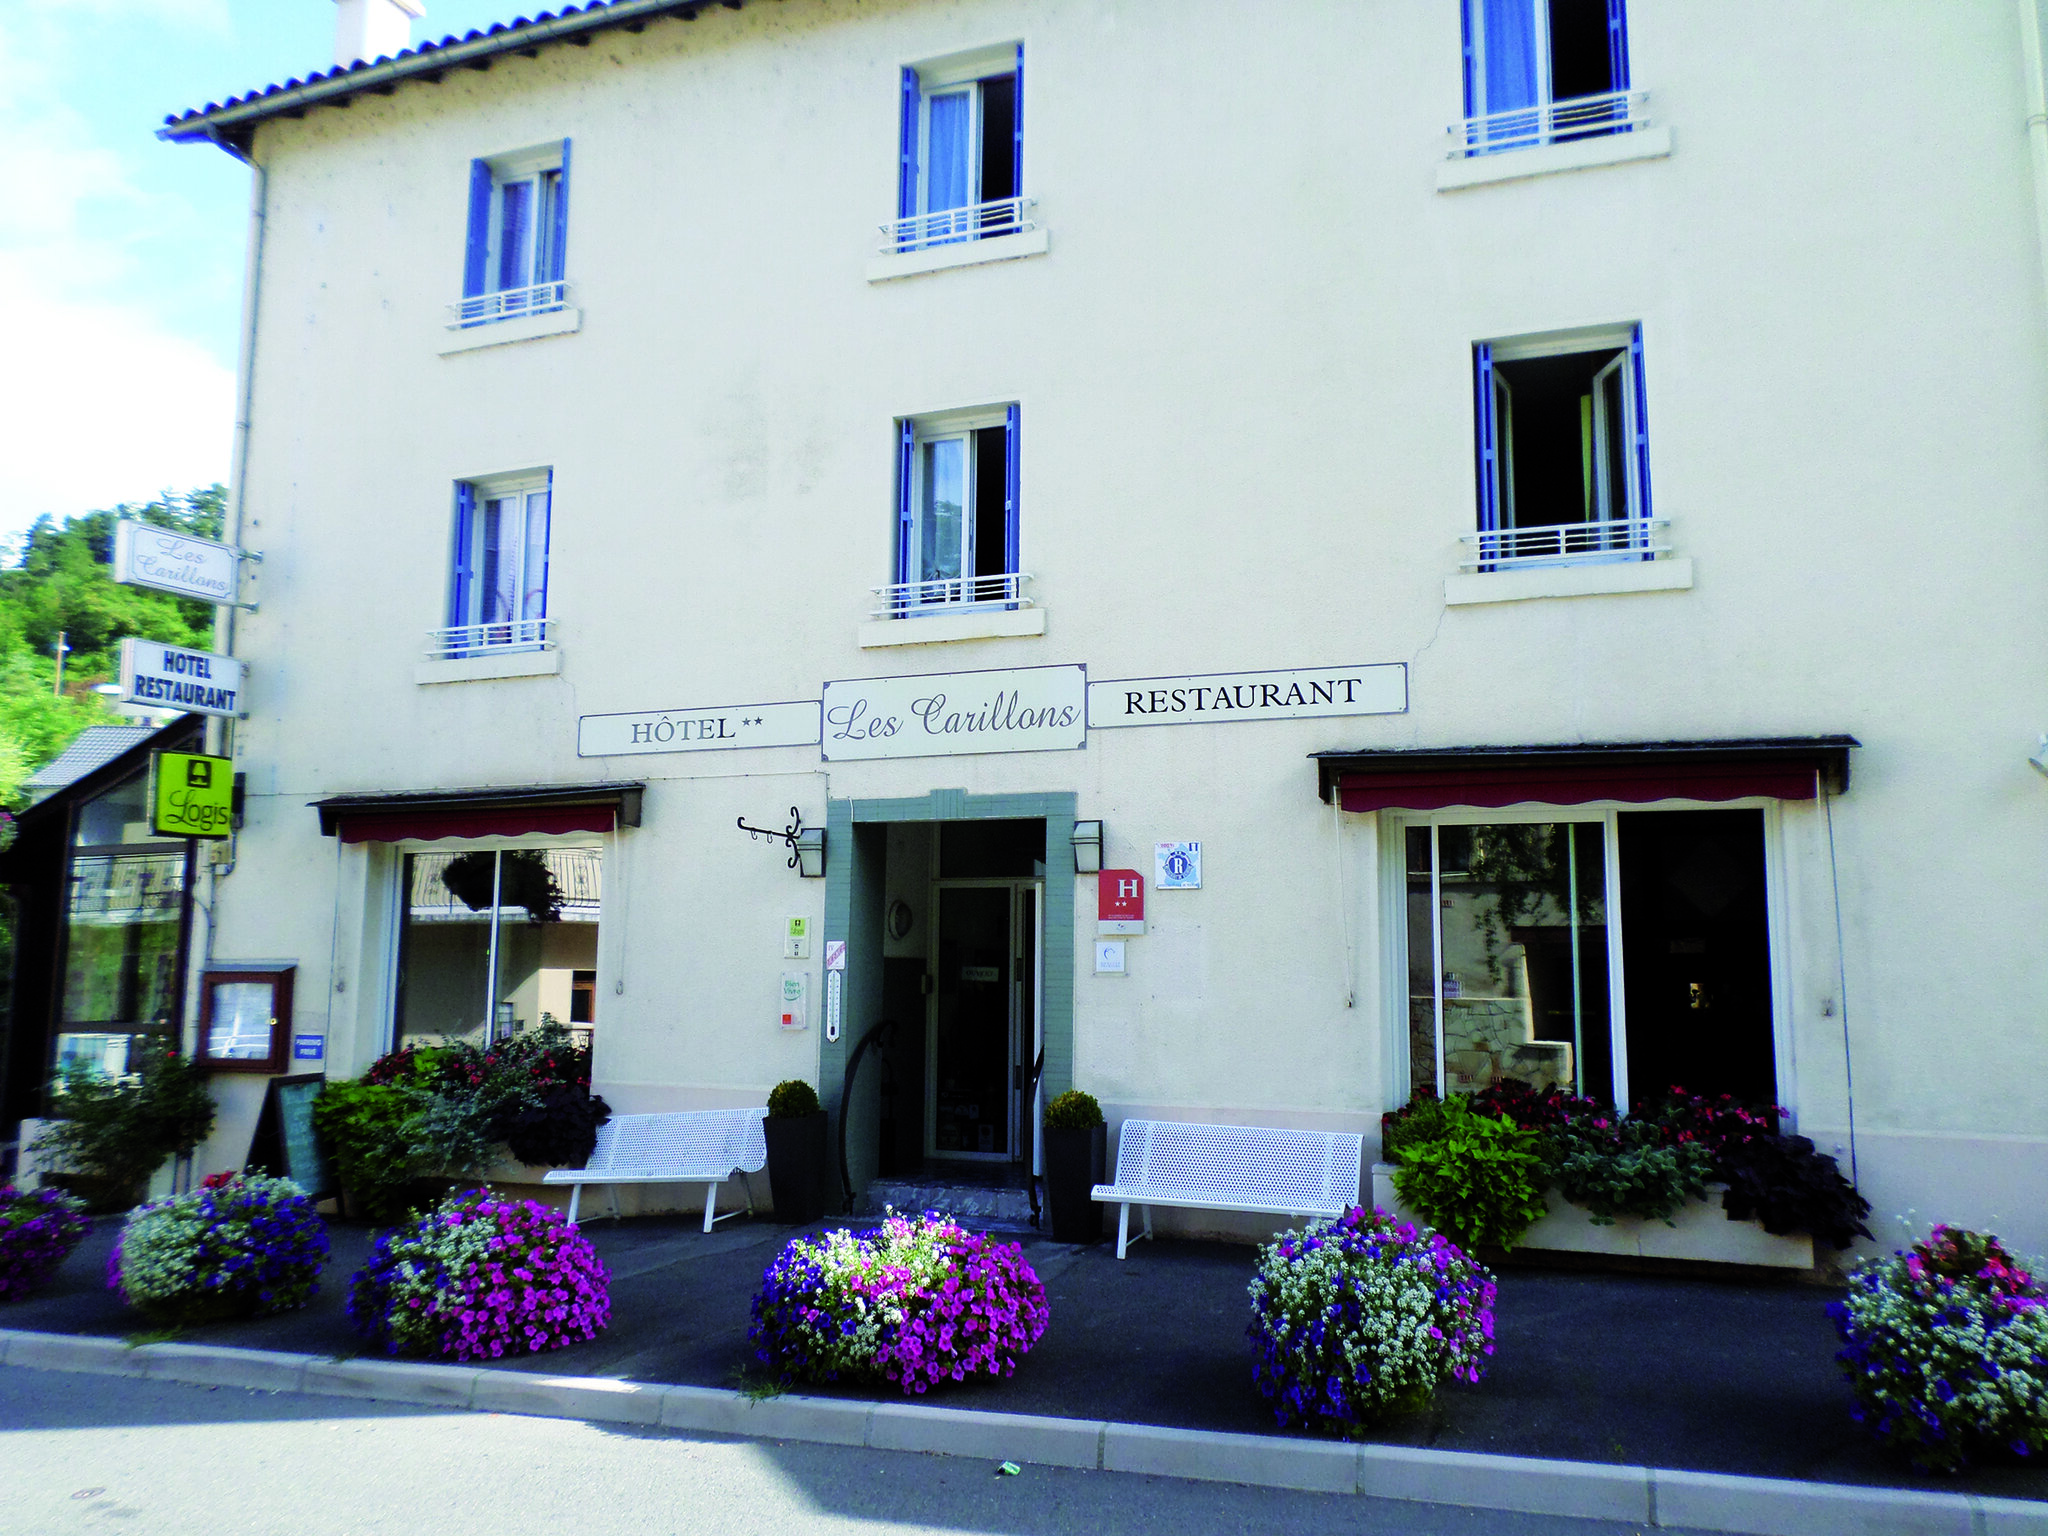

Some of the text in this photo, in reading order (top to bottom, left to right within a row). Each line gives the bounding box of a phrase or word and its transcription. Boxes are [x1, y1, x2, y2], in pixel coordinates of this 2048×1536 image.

[156, 537, 205, 564] Les
[137, 554, 227, 591] Carillons
[163, 650, 212, 680] HOTEL
[135, 674, 236, 711] RESTAURANT
[1124, 678, 1362, 715] RESTAURANT
[630, 715, 736, 744] HÔTEL
[827, 690, 1081, 741] Les Carillons
[165, 789, 228, 831] Logis
[1118, 879, 1139, 898] H
